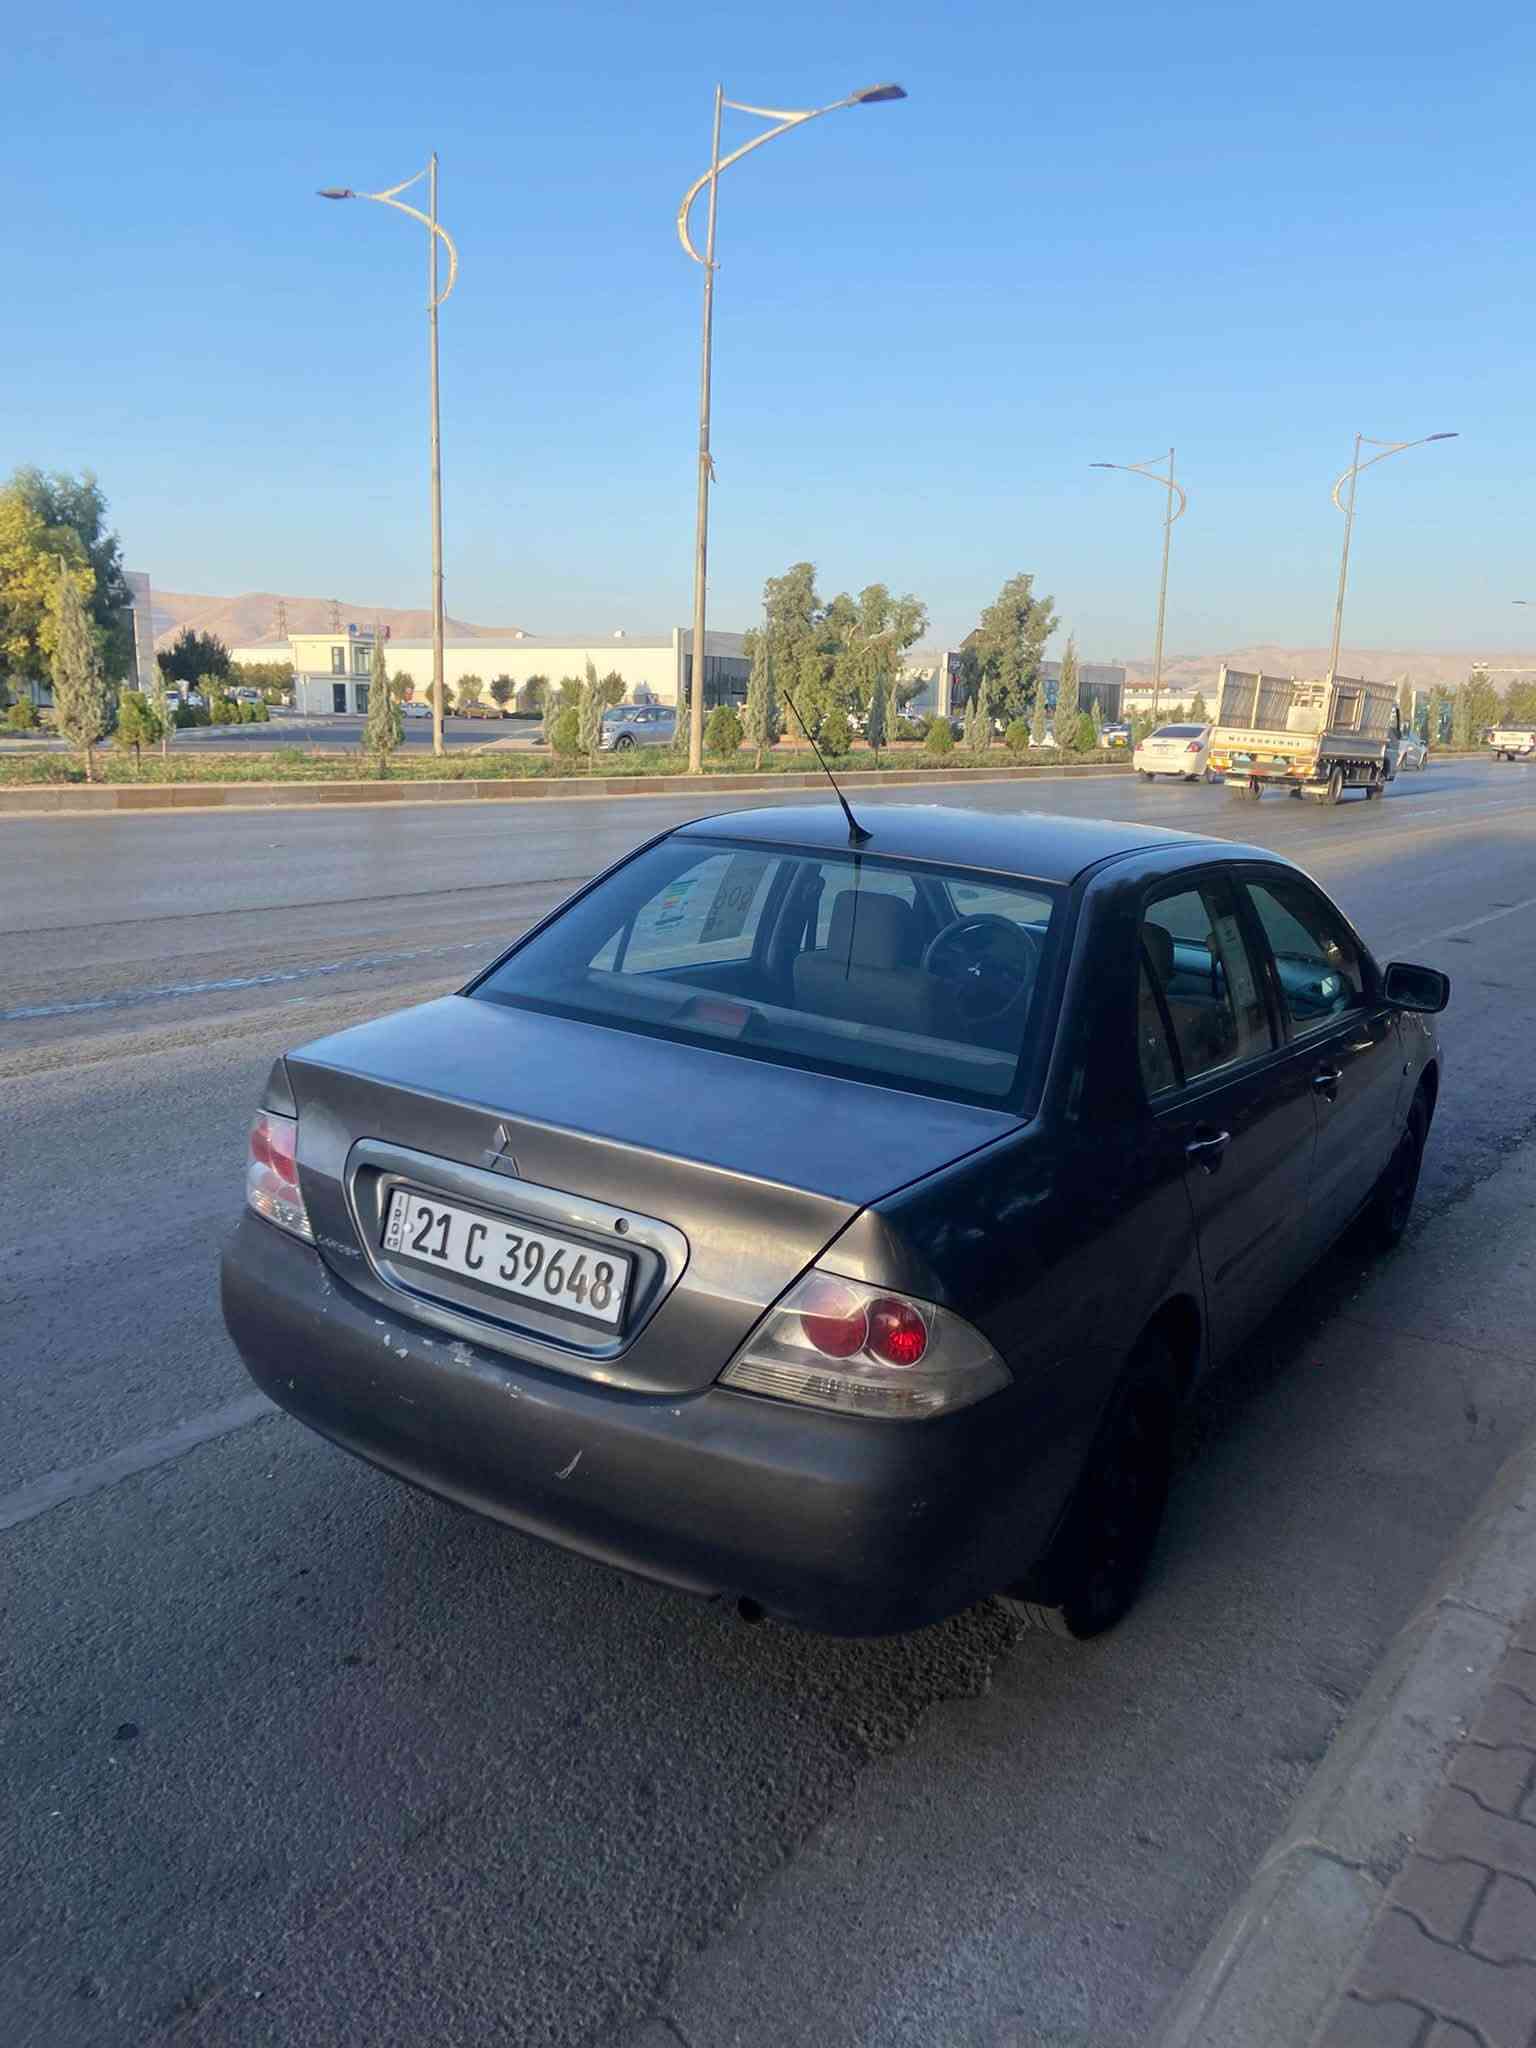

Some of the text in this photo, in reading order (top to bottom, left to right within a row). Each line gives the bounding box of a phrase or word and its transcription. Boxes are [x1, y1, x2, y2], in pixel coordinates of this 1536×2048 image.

[411, 1206, 451, 1261] 21
[465, 1223, 487, 1270] C
[499, 1233, 614, 1310] 39648
